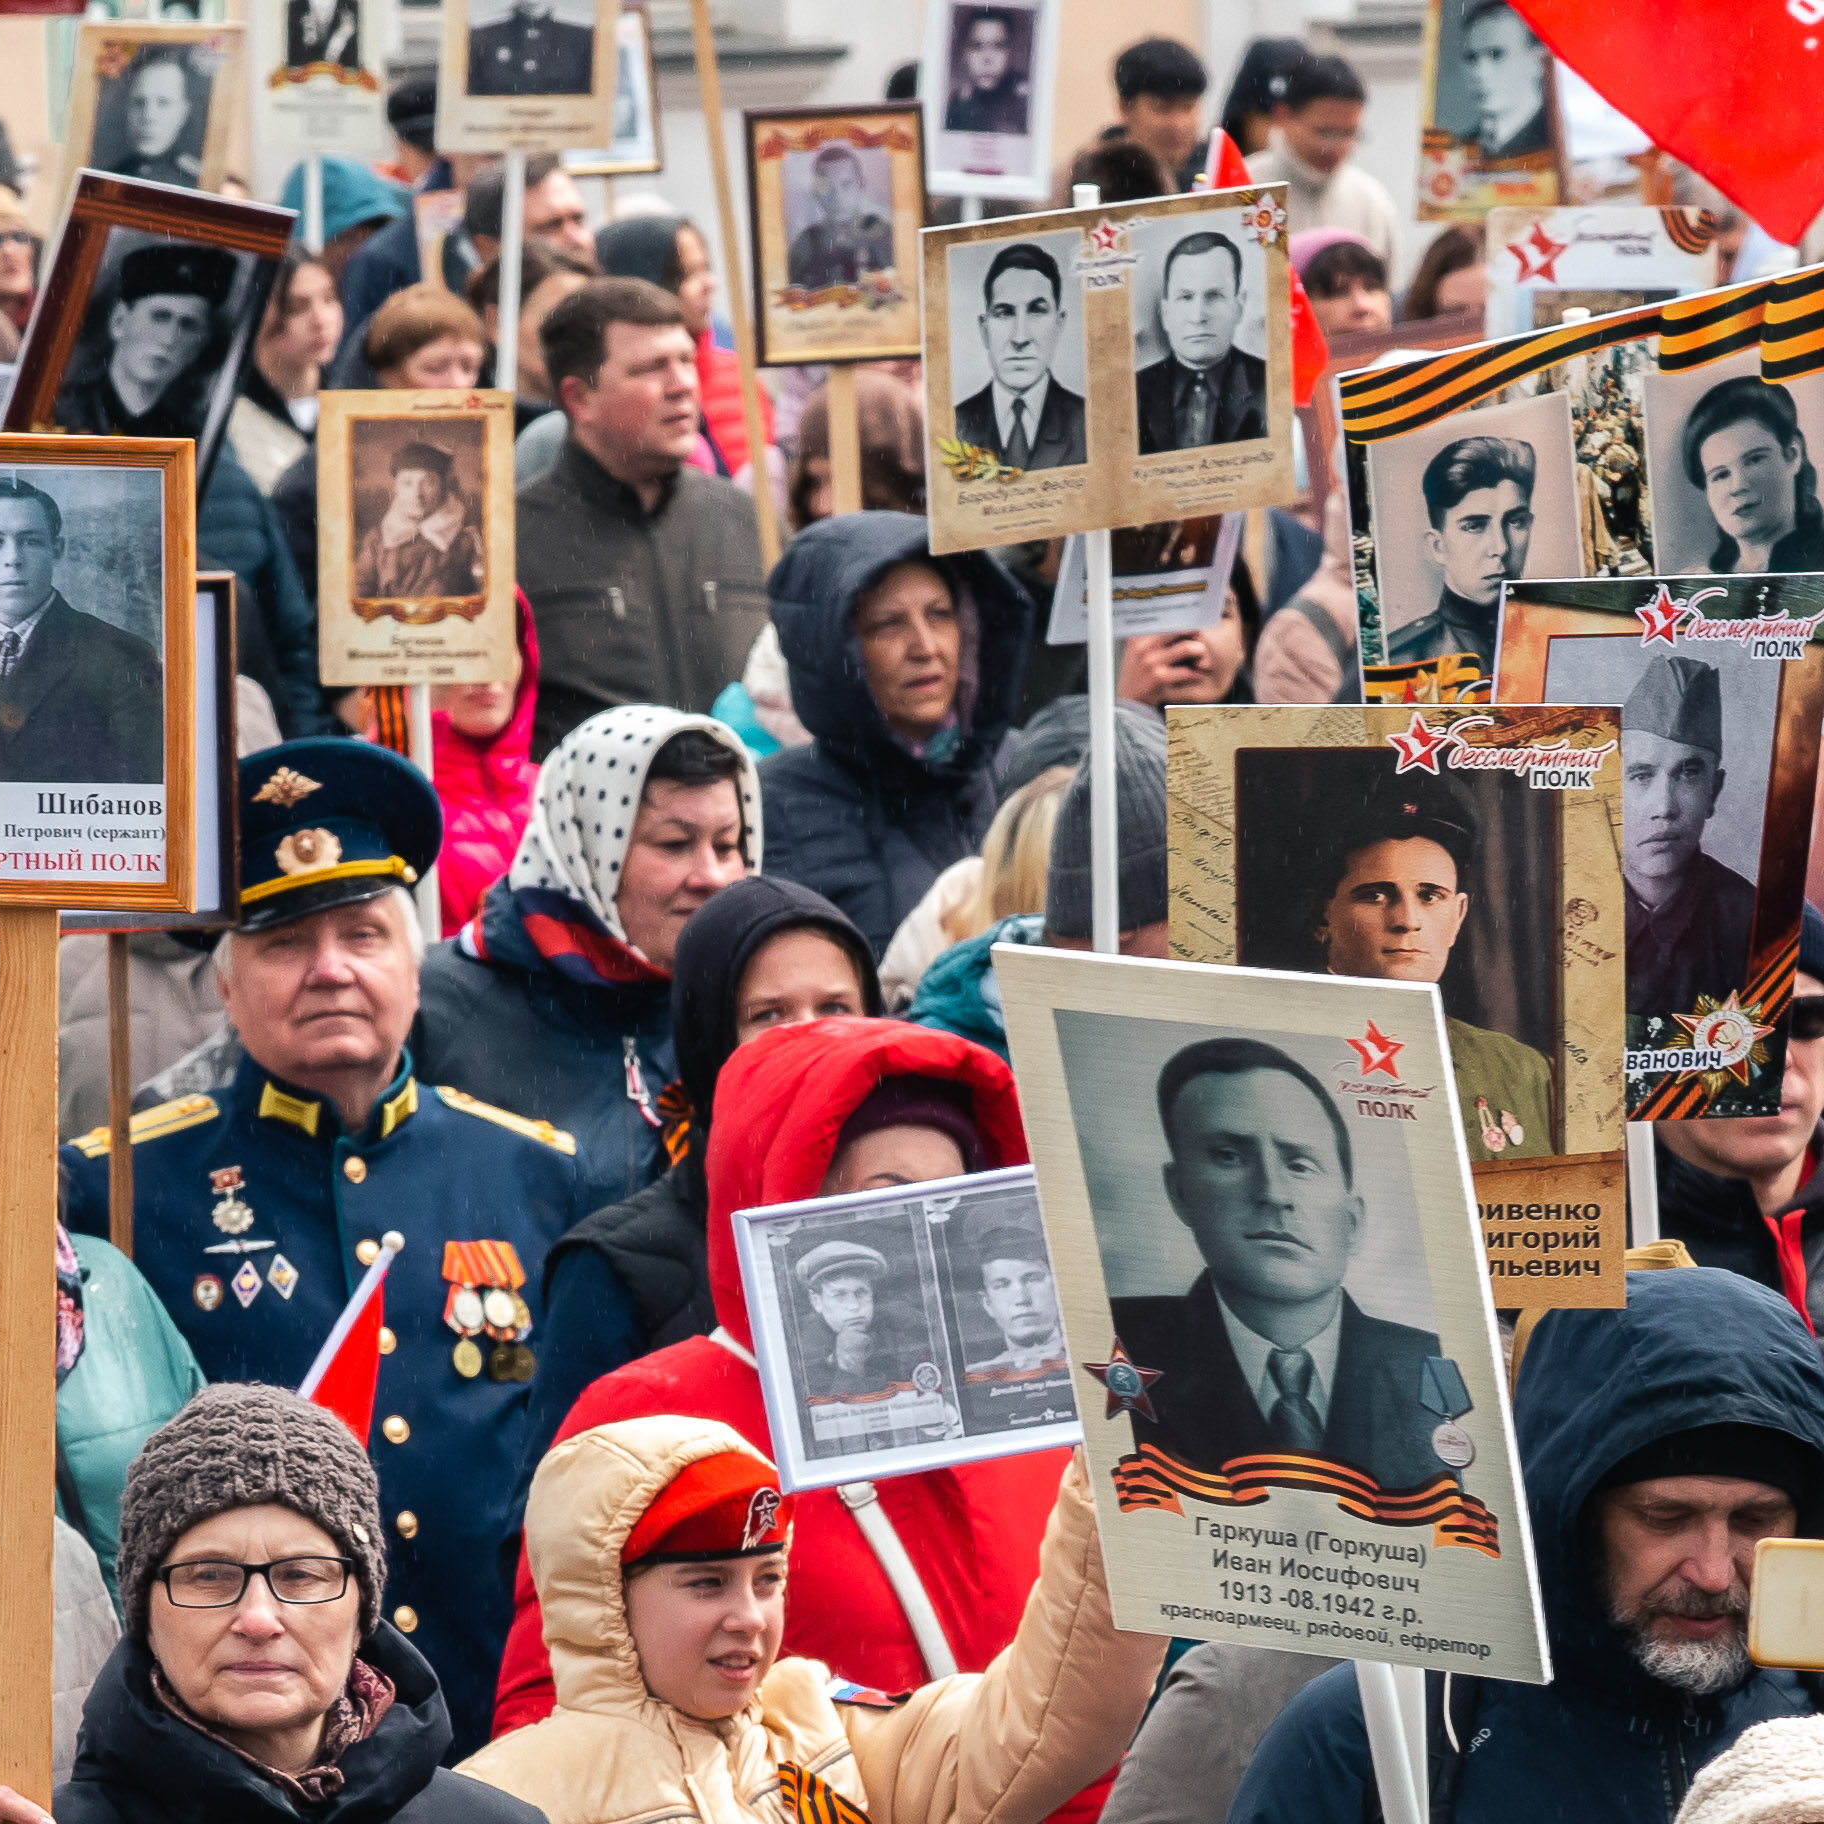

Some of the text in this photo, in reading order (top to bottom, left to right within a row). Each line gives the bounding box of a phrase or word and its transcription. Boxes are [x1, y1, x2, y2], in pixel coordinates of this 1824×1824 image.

[37, 792, 163, 816] Шибанов
[4, 823, 82, 841] Петрович
[87, 825, 166, 842] (сержант)
[91, 853, 161, 872] ПОЛК
[1194, 1517, 1427, 1569] Гаркуша (Горкуша)
[1212, 1548, 1421, 1594] Иван Иосифович
[1219, 1581, 1424, 1626] 1913 -08.1942 г.р.
[1160, 1604, 1492, 1661] красноармеец, рядовой, ефретор
